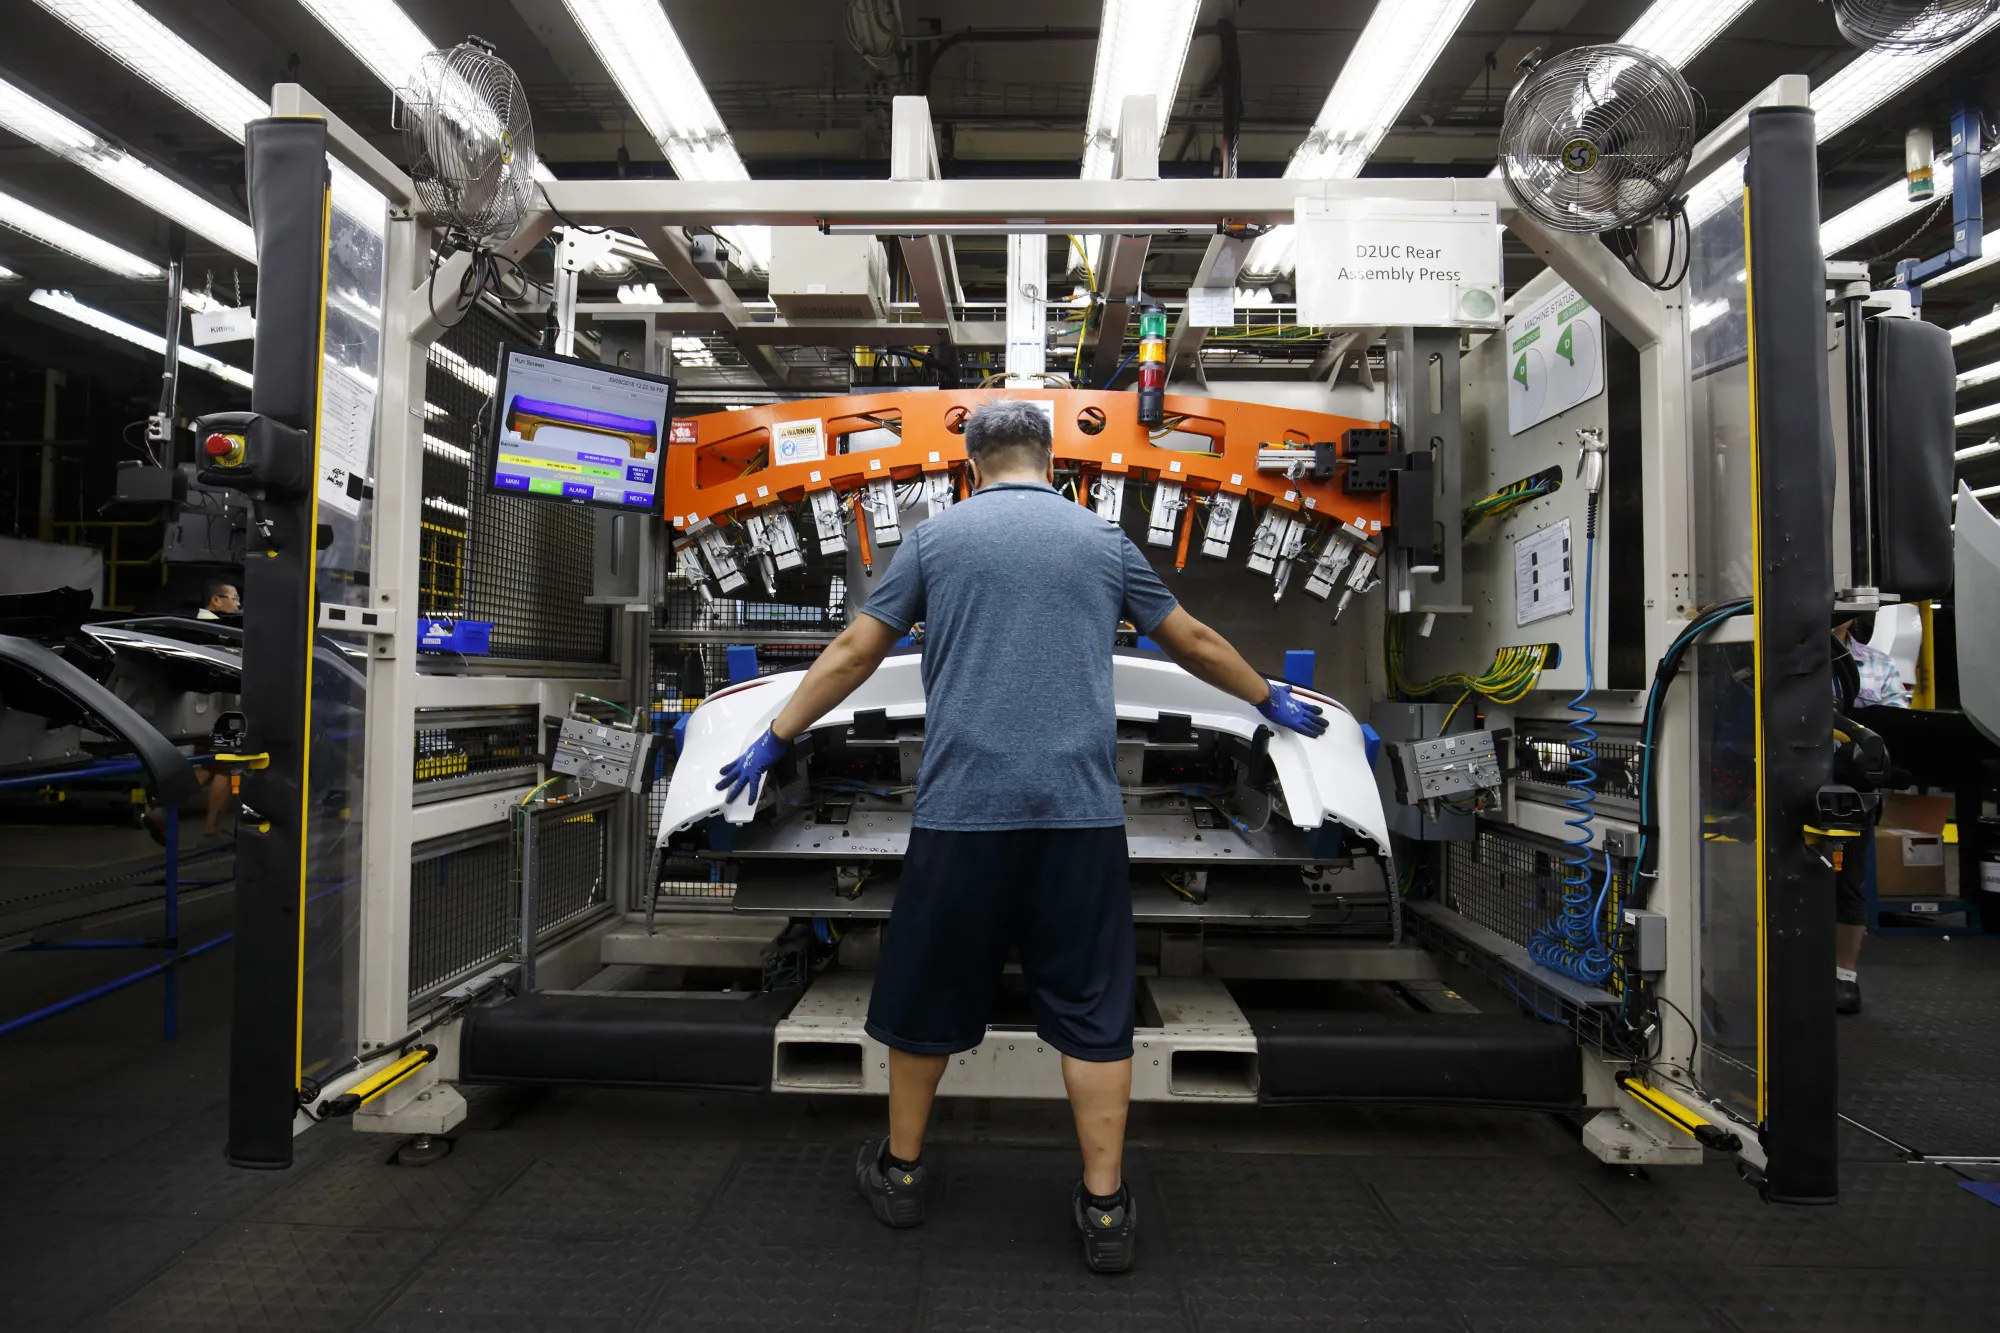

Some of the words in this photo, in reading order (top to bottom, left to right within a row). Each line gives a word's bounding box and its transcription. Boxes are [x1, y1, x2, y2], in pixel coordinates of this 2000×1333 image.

[1356, 244, 1401, 259] D2UC
[1406, 245, 1442, 259] Rear
[1337, 266, 1415, 284] Assembly
[1420, 267, 1461, 281] Press
[1524, 307, 1550, 332] MACHINE
[1551, 290, 1575, 314] STATUS
[210, 324, 235, 333] Kitting
[1565, 338, 1570, 350] D
[514, 357, 526, 365] Run
[526, 359, 545, 369] Screen
[1520, 365, 1525, 376] D
[787, 426, 816, 437] WARNING
[505, 478, 520, 486] MAIN
[568, 486, 588, 495] ALARM
[604, 491, 619, 499] PREV
